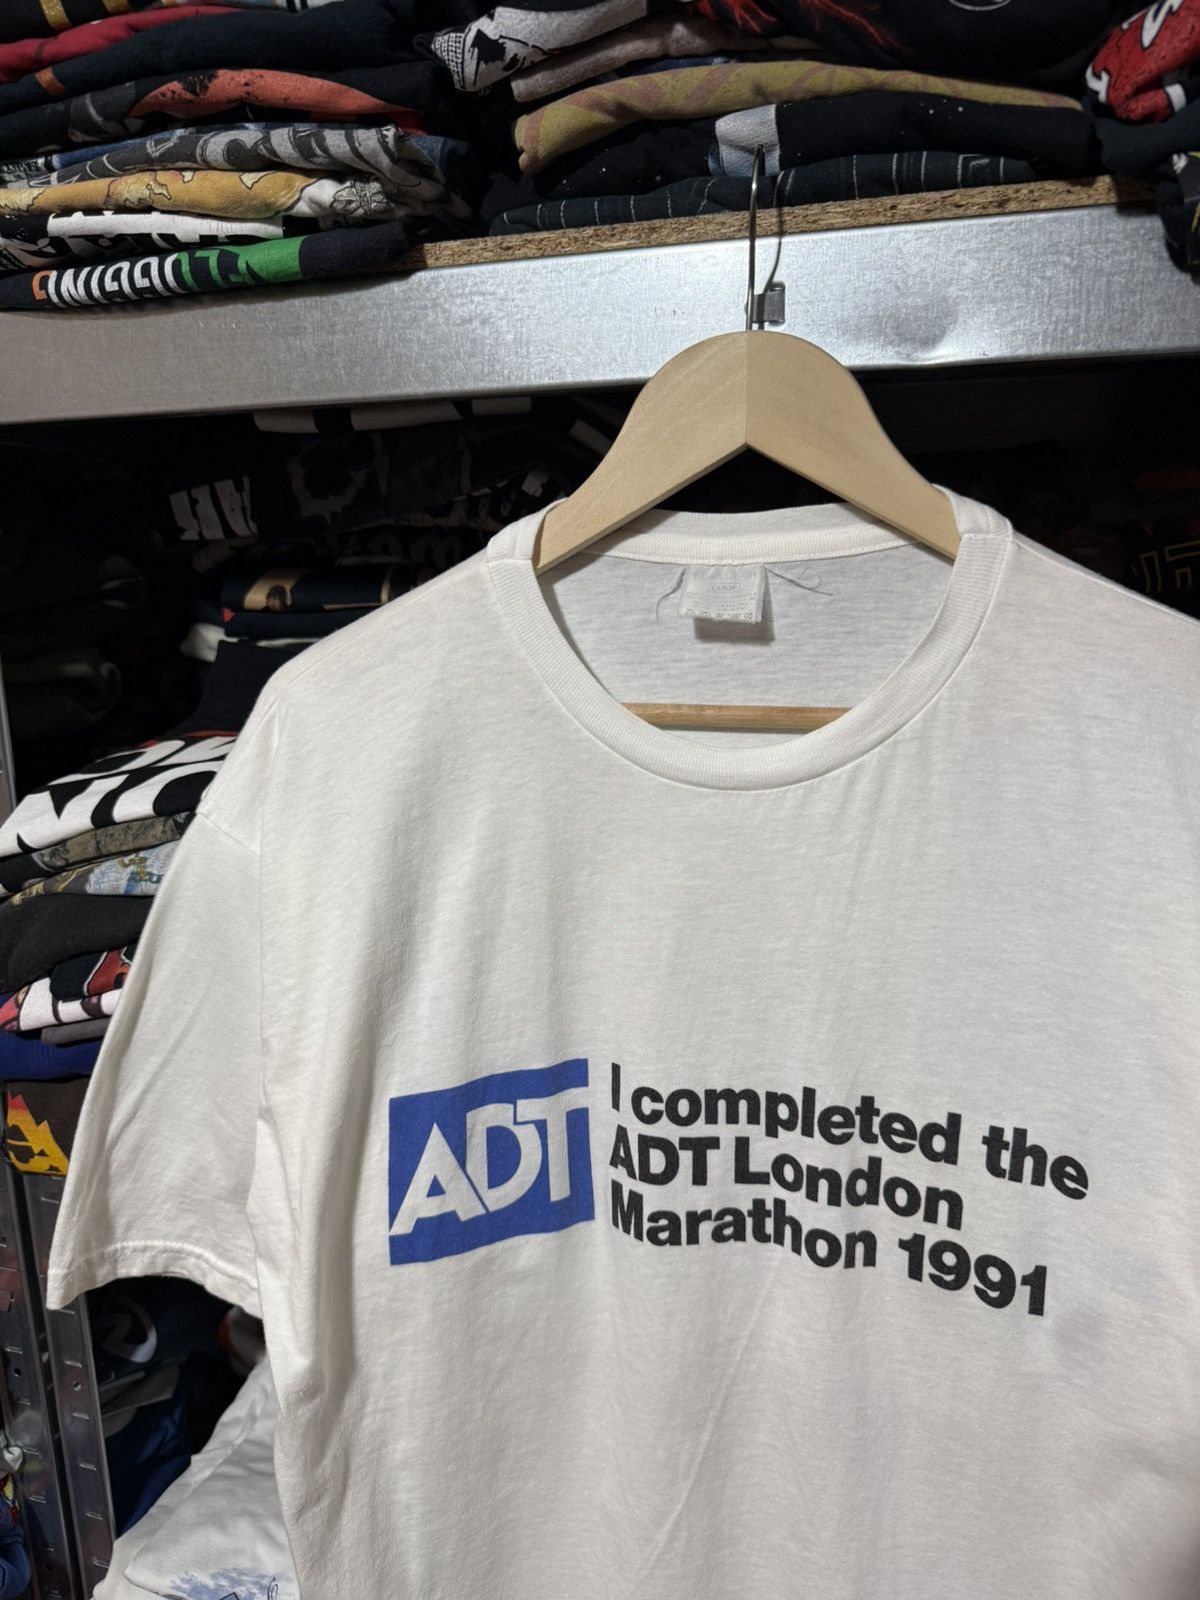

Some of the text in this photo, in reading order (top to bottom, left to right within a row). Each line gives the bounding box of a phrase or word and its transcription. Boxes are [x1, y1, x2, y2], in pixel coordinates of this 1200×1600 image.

[388, 1086, 589, 1236] ADT
[609, 1125, 964, 1231] ADT London
[611, 1062, 1089, 1200] I completed the
[611, 1180, 1047, 1317] Marathon 1991
